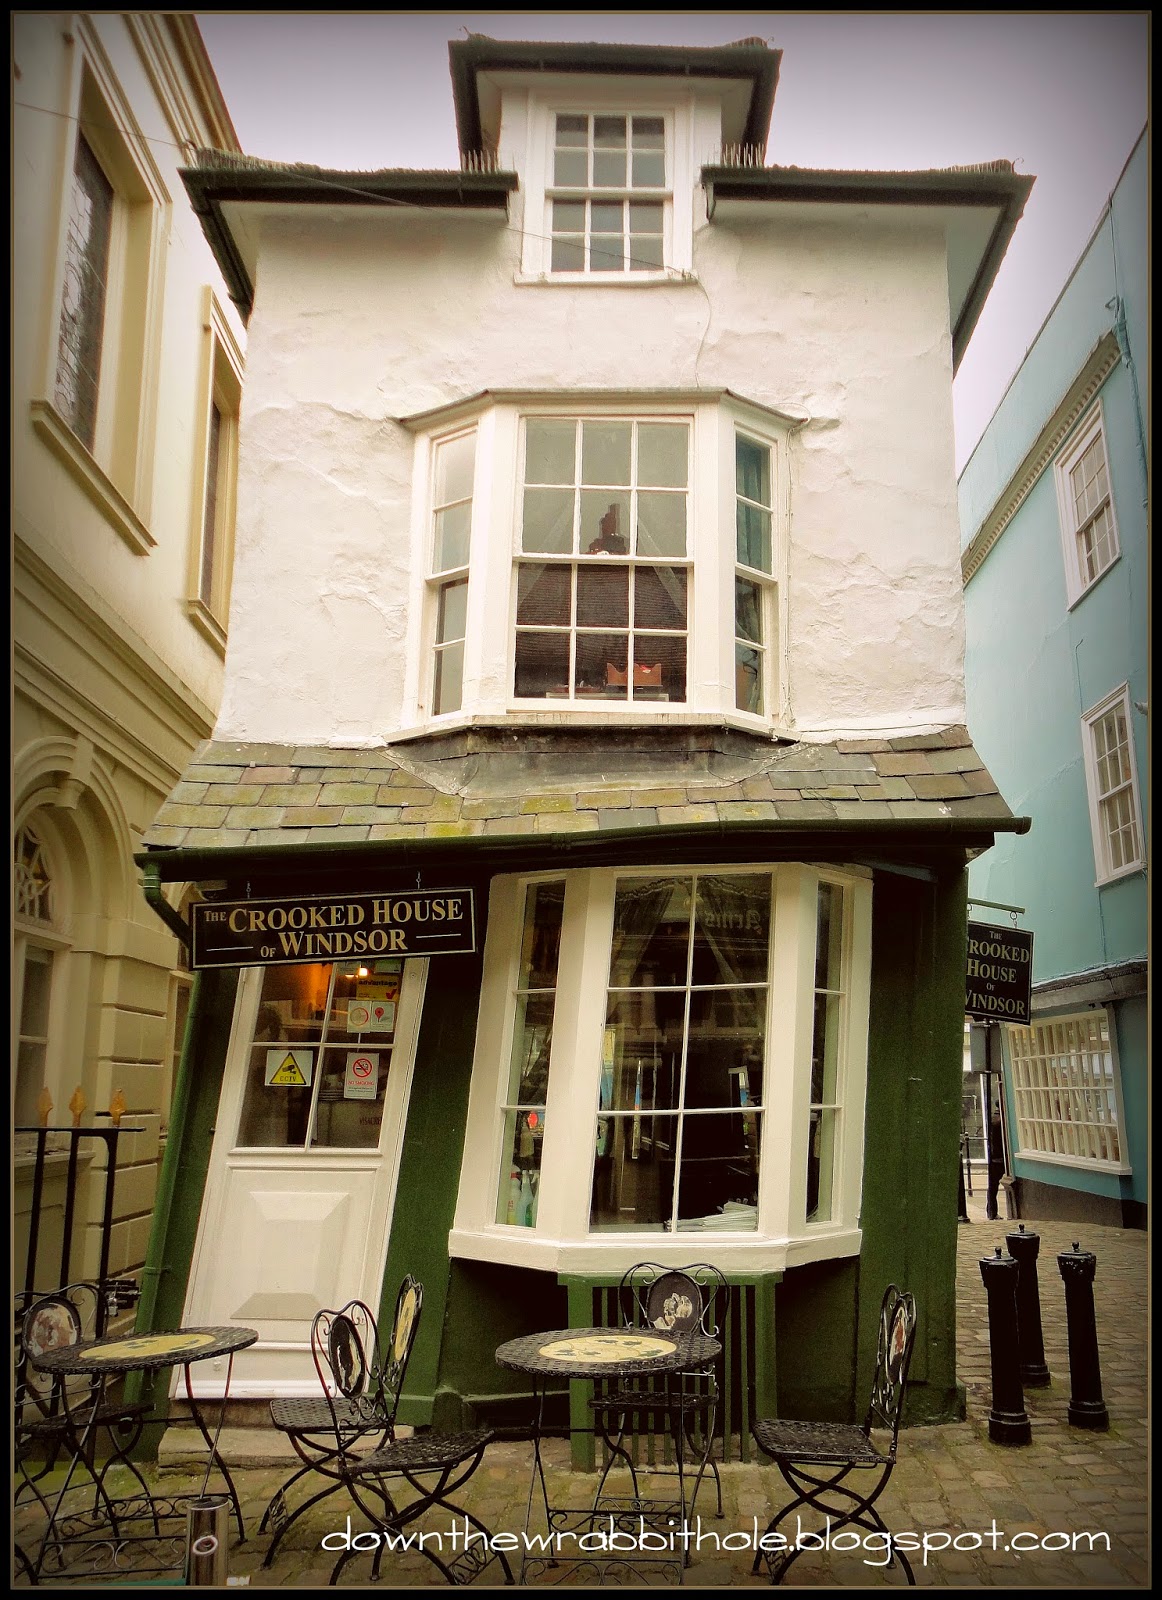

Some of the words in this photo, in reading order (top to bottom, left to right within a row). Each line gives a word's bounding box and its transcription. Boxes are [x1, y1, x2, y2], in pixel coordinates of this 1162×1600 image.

[204, 910, 227, 922] THE
[228, 904, 365, 933] CROOKED
[371, 899, 463, 925] HOUSE
[260, 945, 276, 958] OF
[278, 928, 408, 957] WINDSOR
[989, 931, 1002, 940] THE
[967, 938, 1029, 963] ROOKED
[966, 959, 1016, 983] HOUSE
[986, 983, 995, 991] OF
